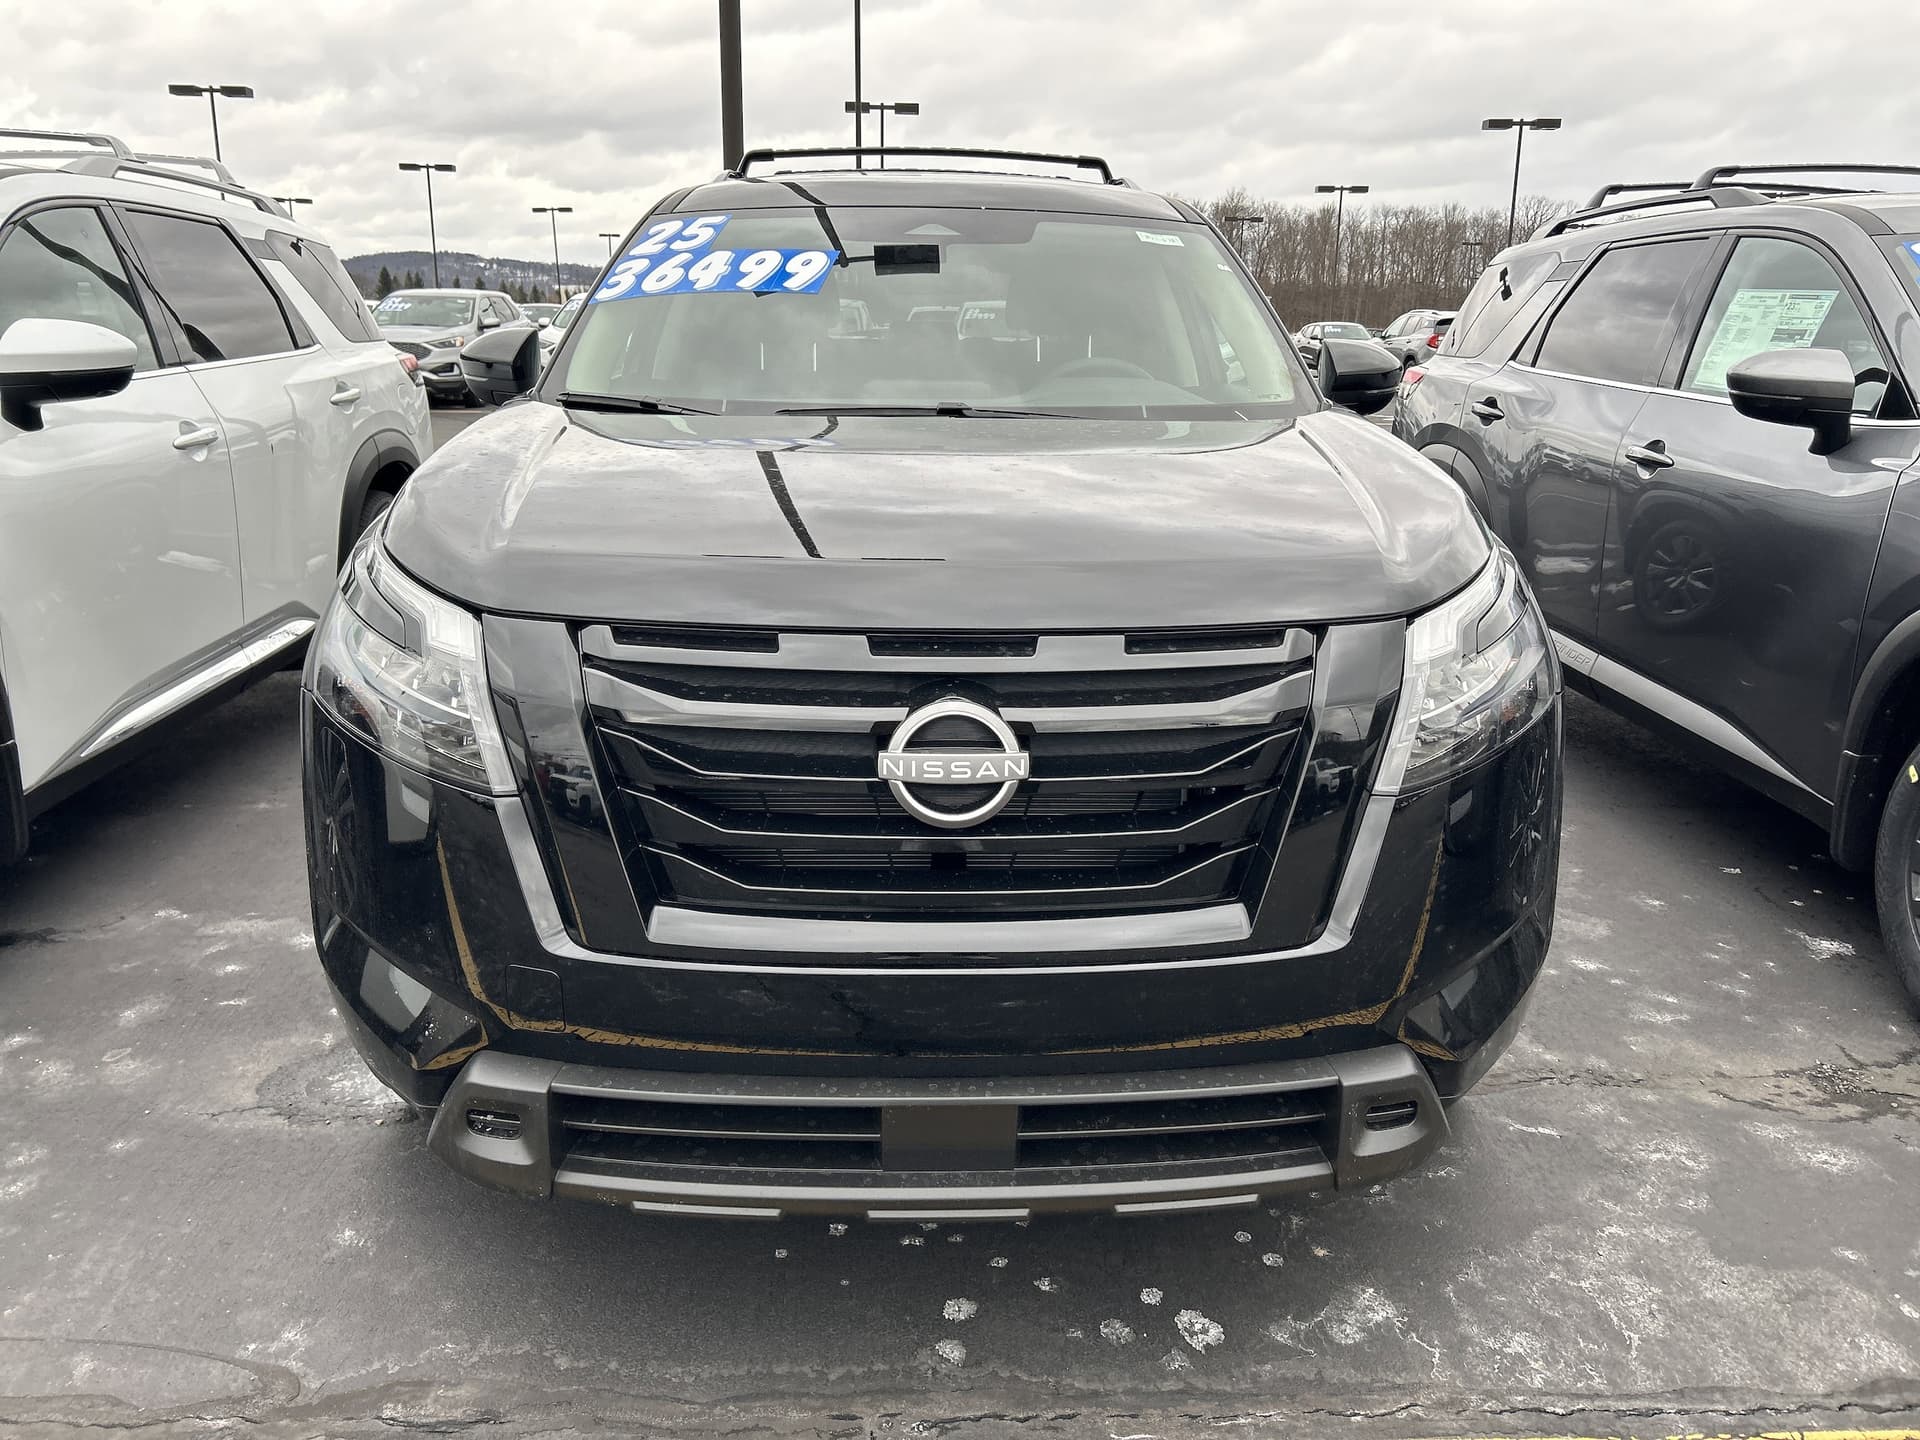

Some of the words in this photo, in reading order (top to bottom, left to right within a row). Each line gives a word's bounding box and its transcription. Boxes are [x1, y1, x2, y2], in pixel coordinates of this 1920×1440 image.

[628, 215, 729, 257] 25
[594, 249, 831, 301] 36499
[882, 758, 1025, 779] NISSAN
